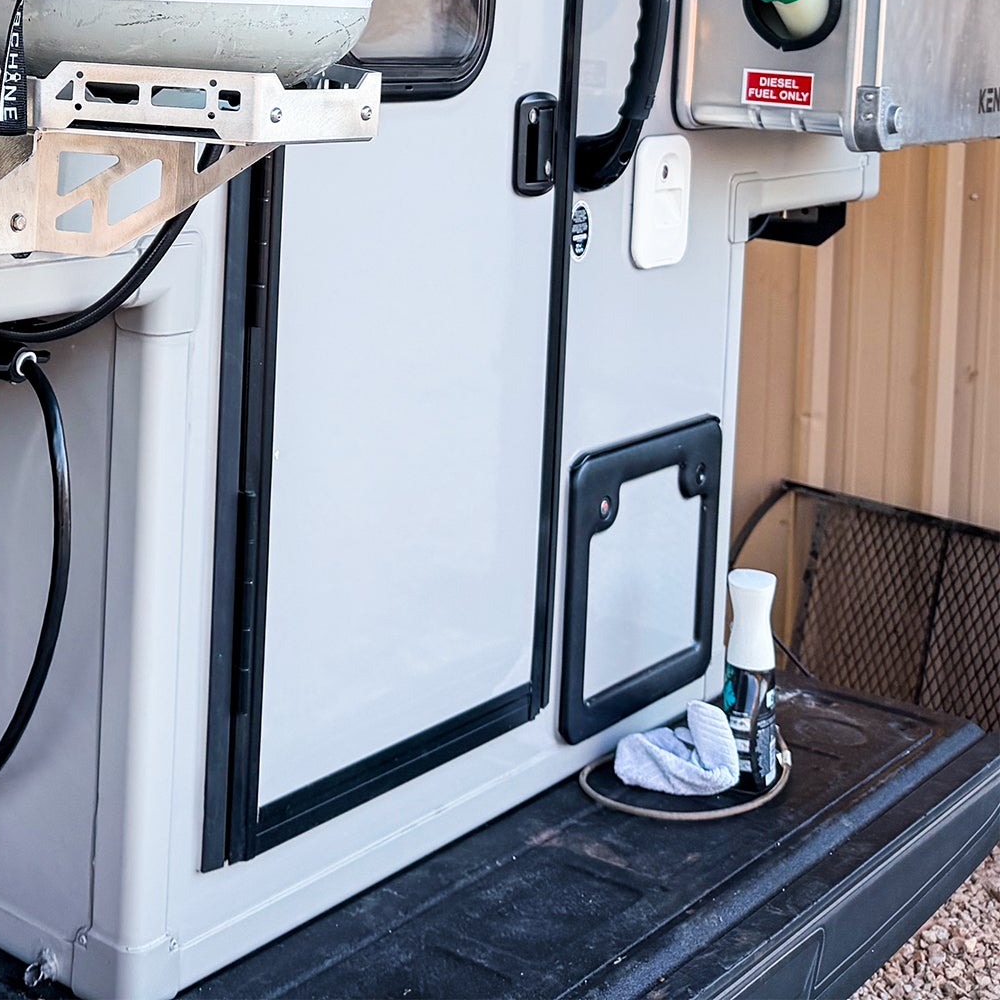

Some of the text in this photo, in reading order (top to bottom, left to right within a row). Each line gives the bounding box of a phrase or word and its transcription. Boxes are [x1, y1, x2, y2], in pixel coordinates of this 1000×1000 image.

[759, 77, 799, 89] DIESEL
[748, 88, 810, 102] FUEL ONLY
